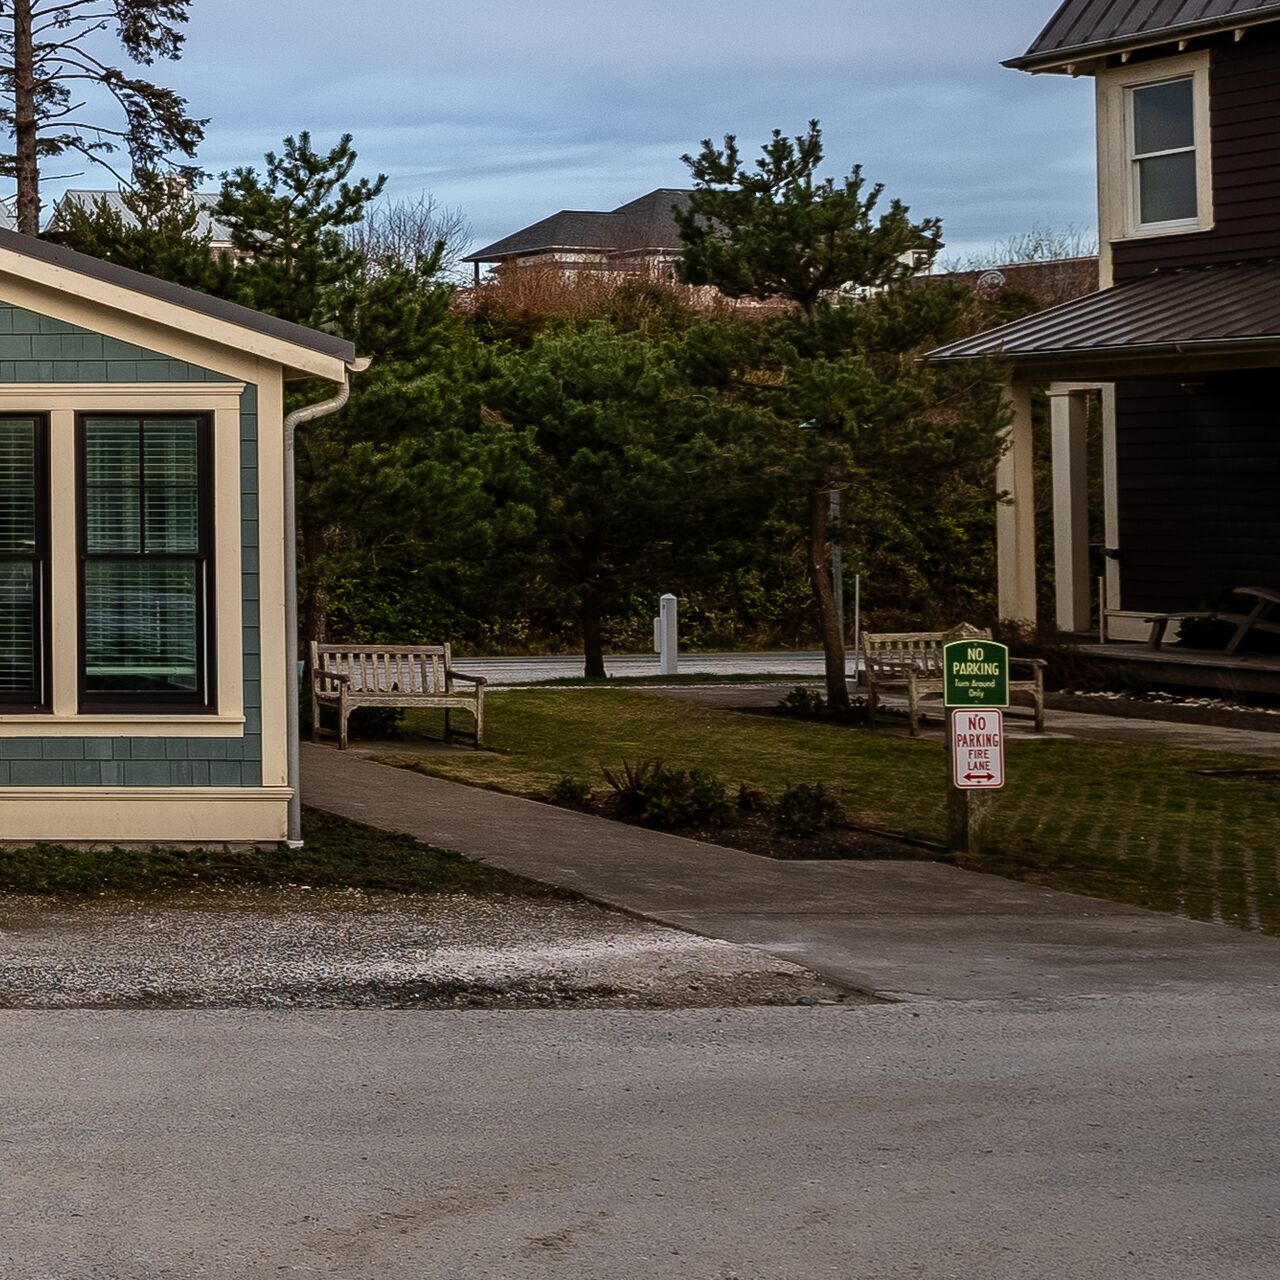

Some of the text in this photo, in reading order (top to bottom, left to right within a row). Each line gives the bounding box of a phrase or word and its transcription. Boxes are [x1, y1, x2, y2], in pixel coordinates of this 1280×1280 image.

[967, 647, 984, 661] NO
[953, 662, 999, 675] PARKING
[955, 679, 996, 688] Turn Around
[968, 688, 985, 699] Only
[968, 716, 987, 731] NO
[957, 733, 999, 748] PARKING
[968, 749, 989, 759] FIRE
[967, 761, 991, 771] LANE
